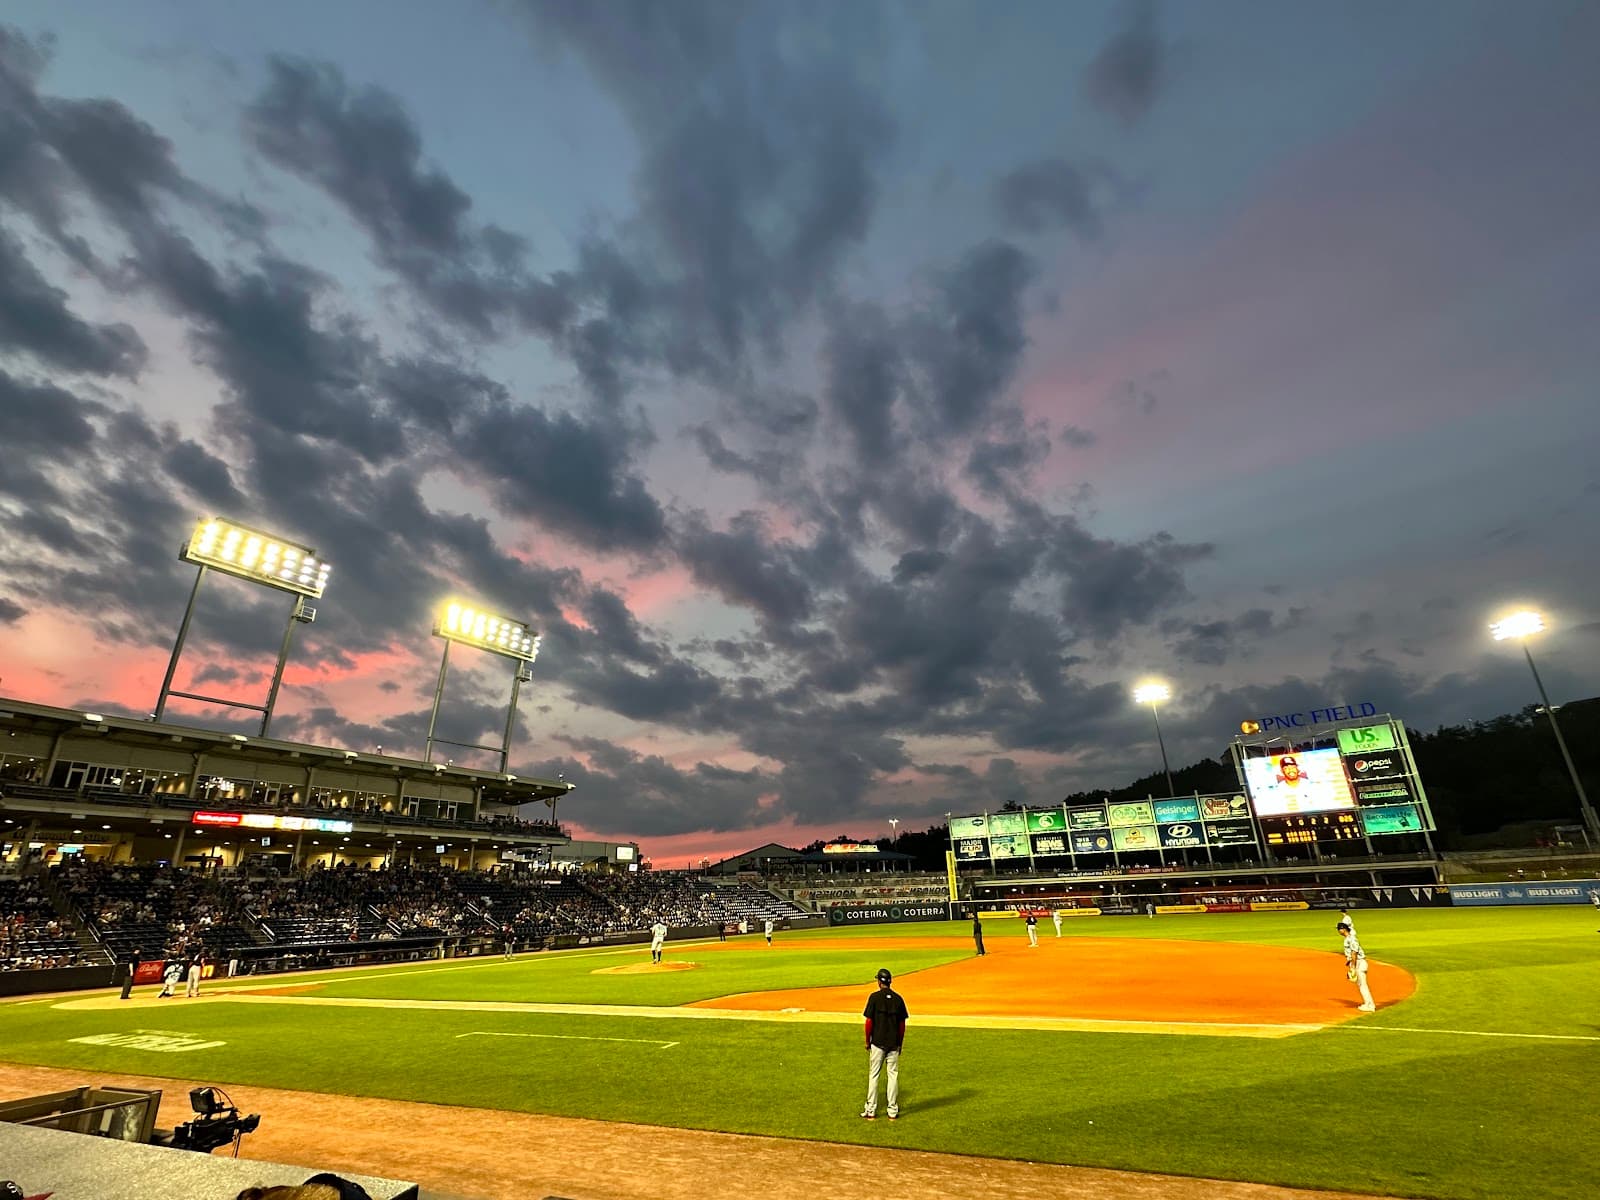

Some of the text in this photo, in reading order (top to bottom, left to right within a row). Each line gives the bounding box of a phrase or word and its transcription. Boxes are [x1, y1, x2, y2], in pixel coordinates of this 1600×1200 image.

[1260, 702, 1376, 731] PNC FIELD
[1368, 758, 1392, 767] pepsi
[1156, 806, 1196, 815] Geisinger
[1165, 837, 1200, 846] HYUNDAI
[1528, 888, 1580, 896] BUD LIGHT
[846, 909, 888, 919] COTERRA
[903, 907, 945, 917] COTERRA
